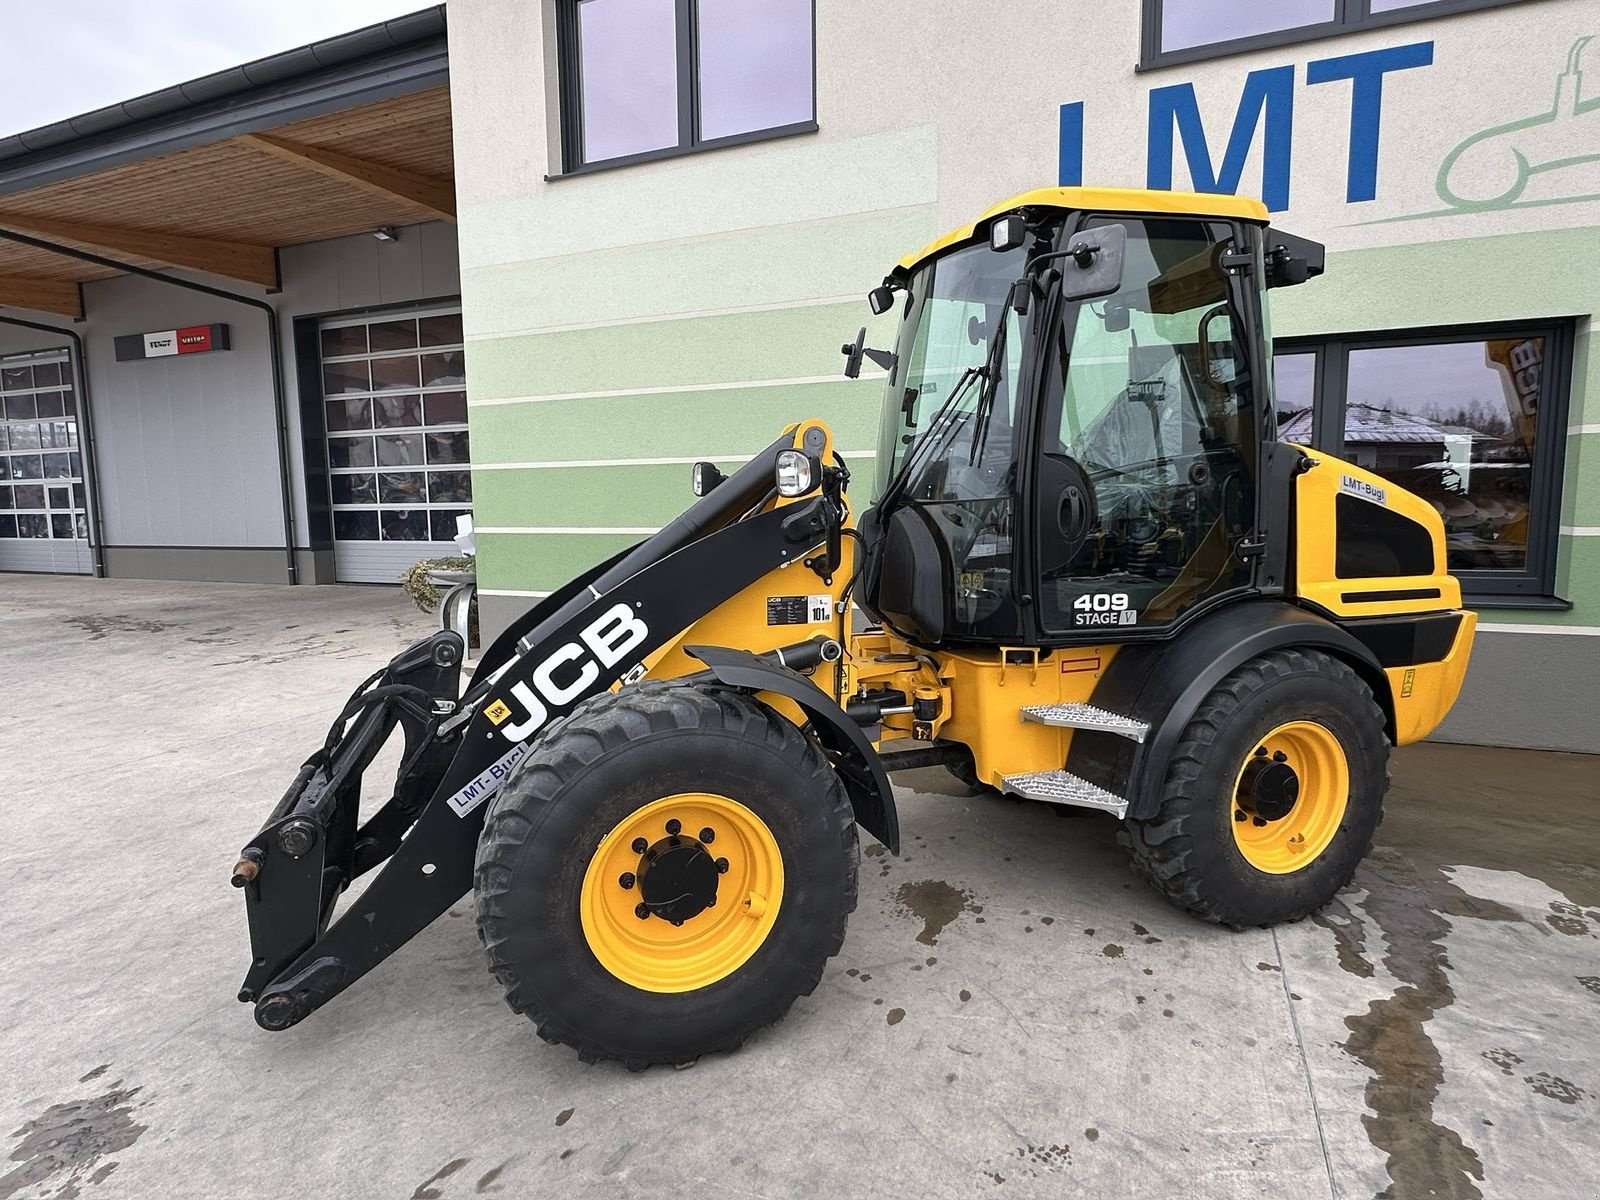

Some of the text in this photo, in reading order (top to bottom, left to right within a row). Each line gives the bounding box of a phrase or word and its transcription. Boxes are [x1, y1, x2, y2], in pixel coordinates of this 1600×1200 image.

[1058, 41, 1434, 213] LMT
[1343, 475, 1385, 501] LMT-Bugl
[1073, 593, 1129, 612] 409
[812, 607, 825, 621] 101
[1075, 612, 1118, 625] STAGE
[500, 602, 649, 743] JCB
